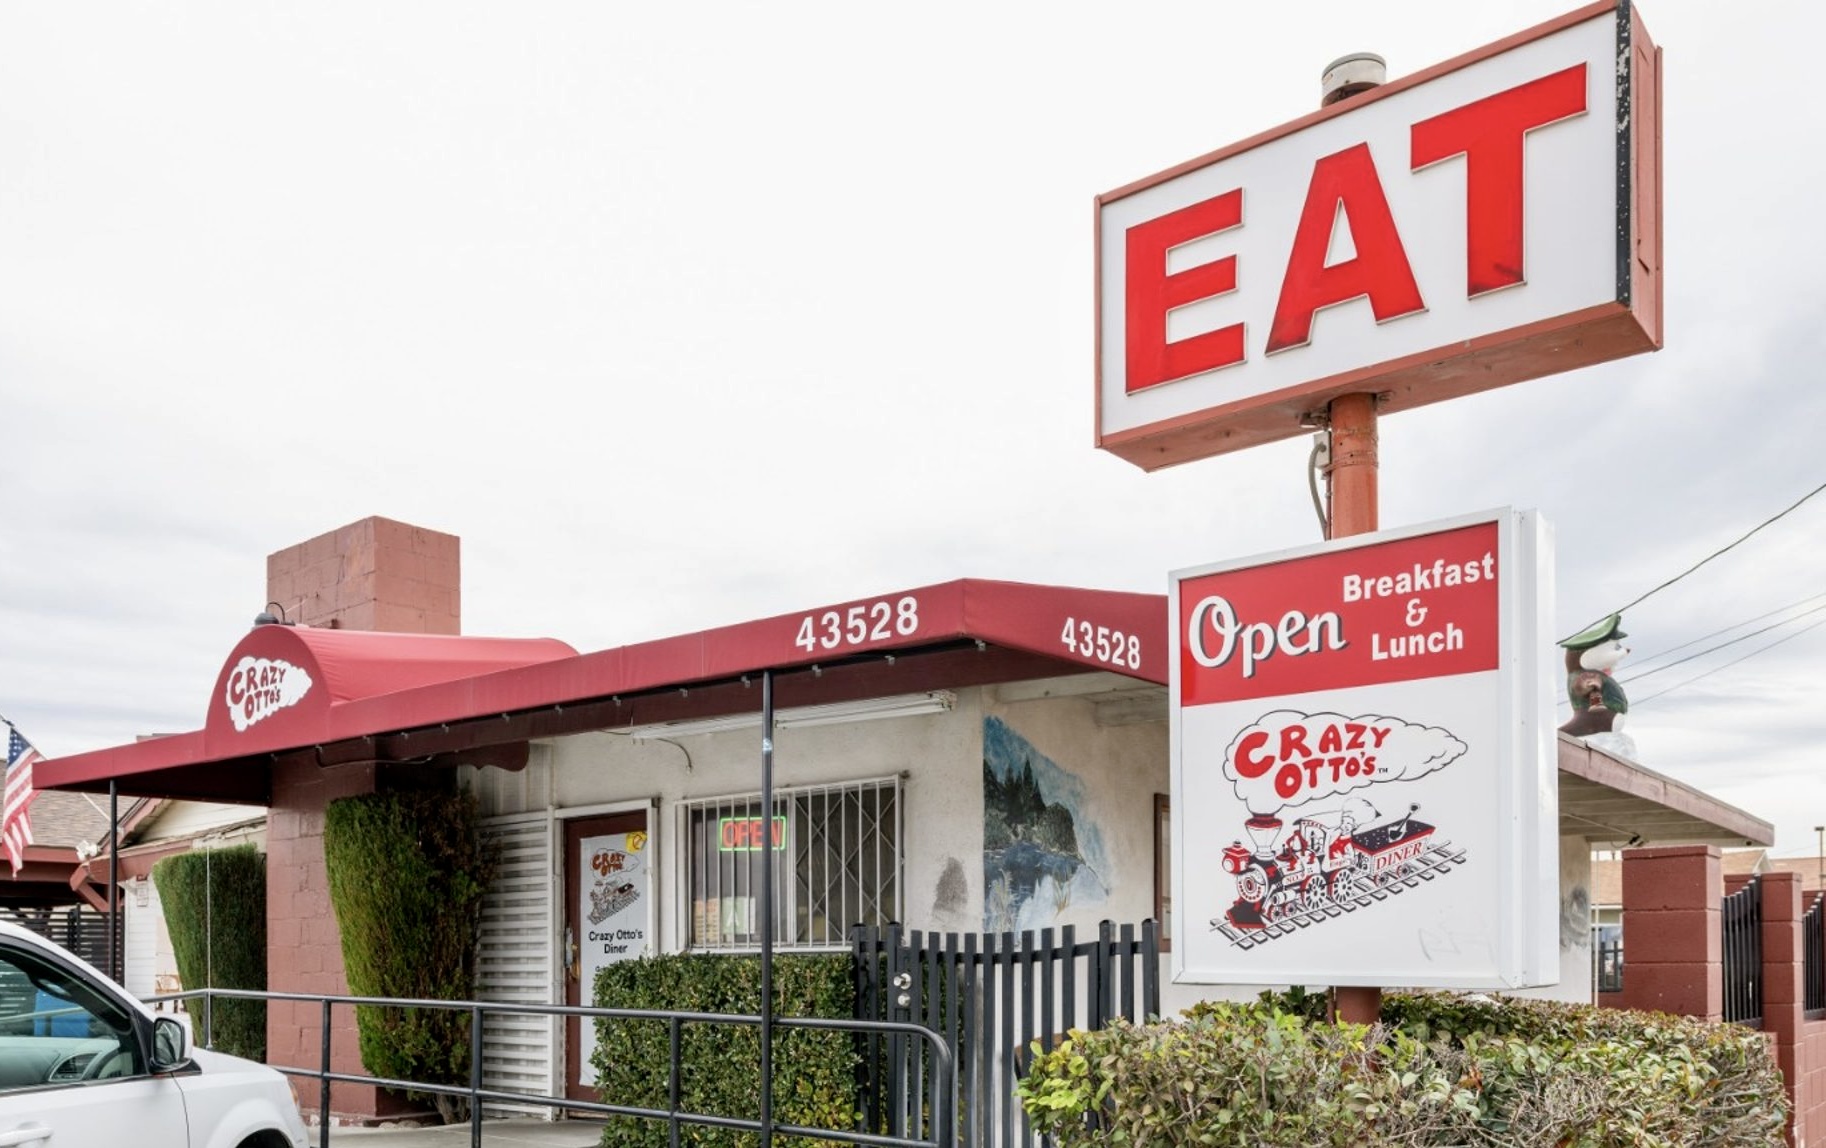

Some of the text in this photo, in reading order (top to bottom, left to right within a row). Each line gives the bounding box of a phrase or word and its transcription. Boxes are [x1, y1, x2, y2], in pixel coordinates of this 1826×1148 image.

[1125, 61, 1588, 395] EAT
[1343, 551, 1495, 602] Breakfast
[795, 596, 919, 652] 43528
[1406, 598, 1428, 627] &
[1061, 617, 1141, 670] 43528
[1189, 595, 1347, 678] Open
[1371, 623, 1464, 661] Lunch
[230, 666, 286, 705] CRAZY
[244, 685, 281, 720] OTTO'S
[1234, 723, 1392, 779] CRAZY
[1274, 751, 1377, 799] OTTO'S
[722, 821, 783, 847] OPEN
[1375, 842, 1422, 870] DINER
[588, 929, 644, 943] Crazy Otto's
[604, 943, 628, 954] Diner
